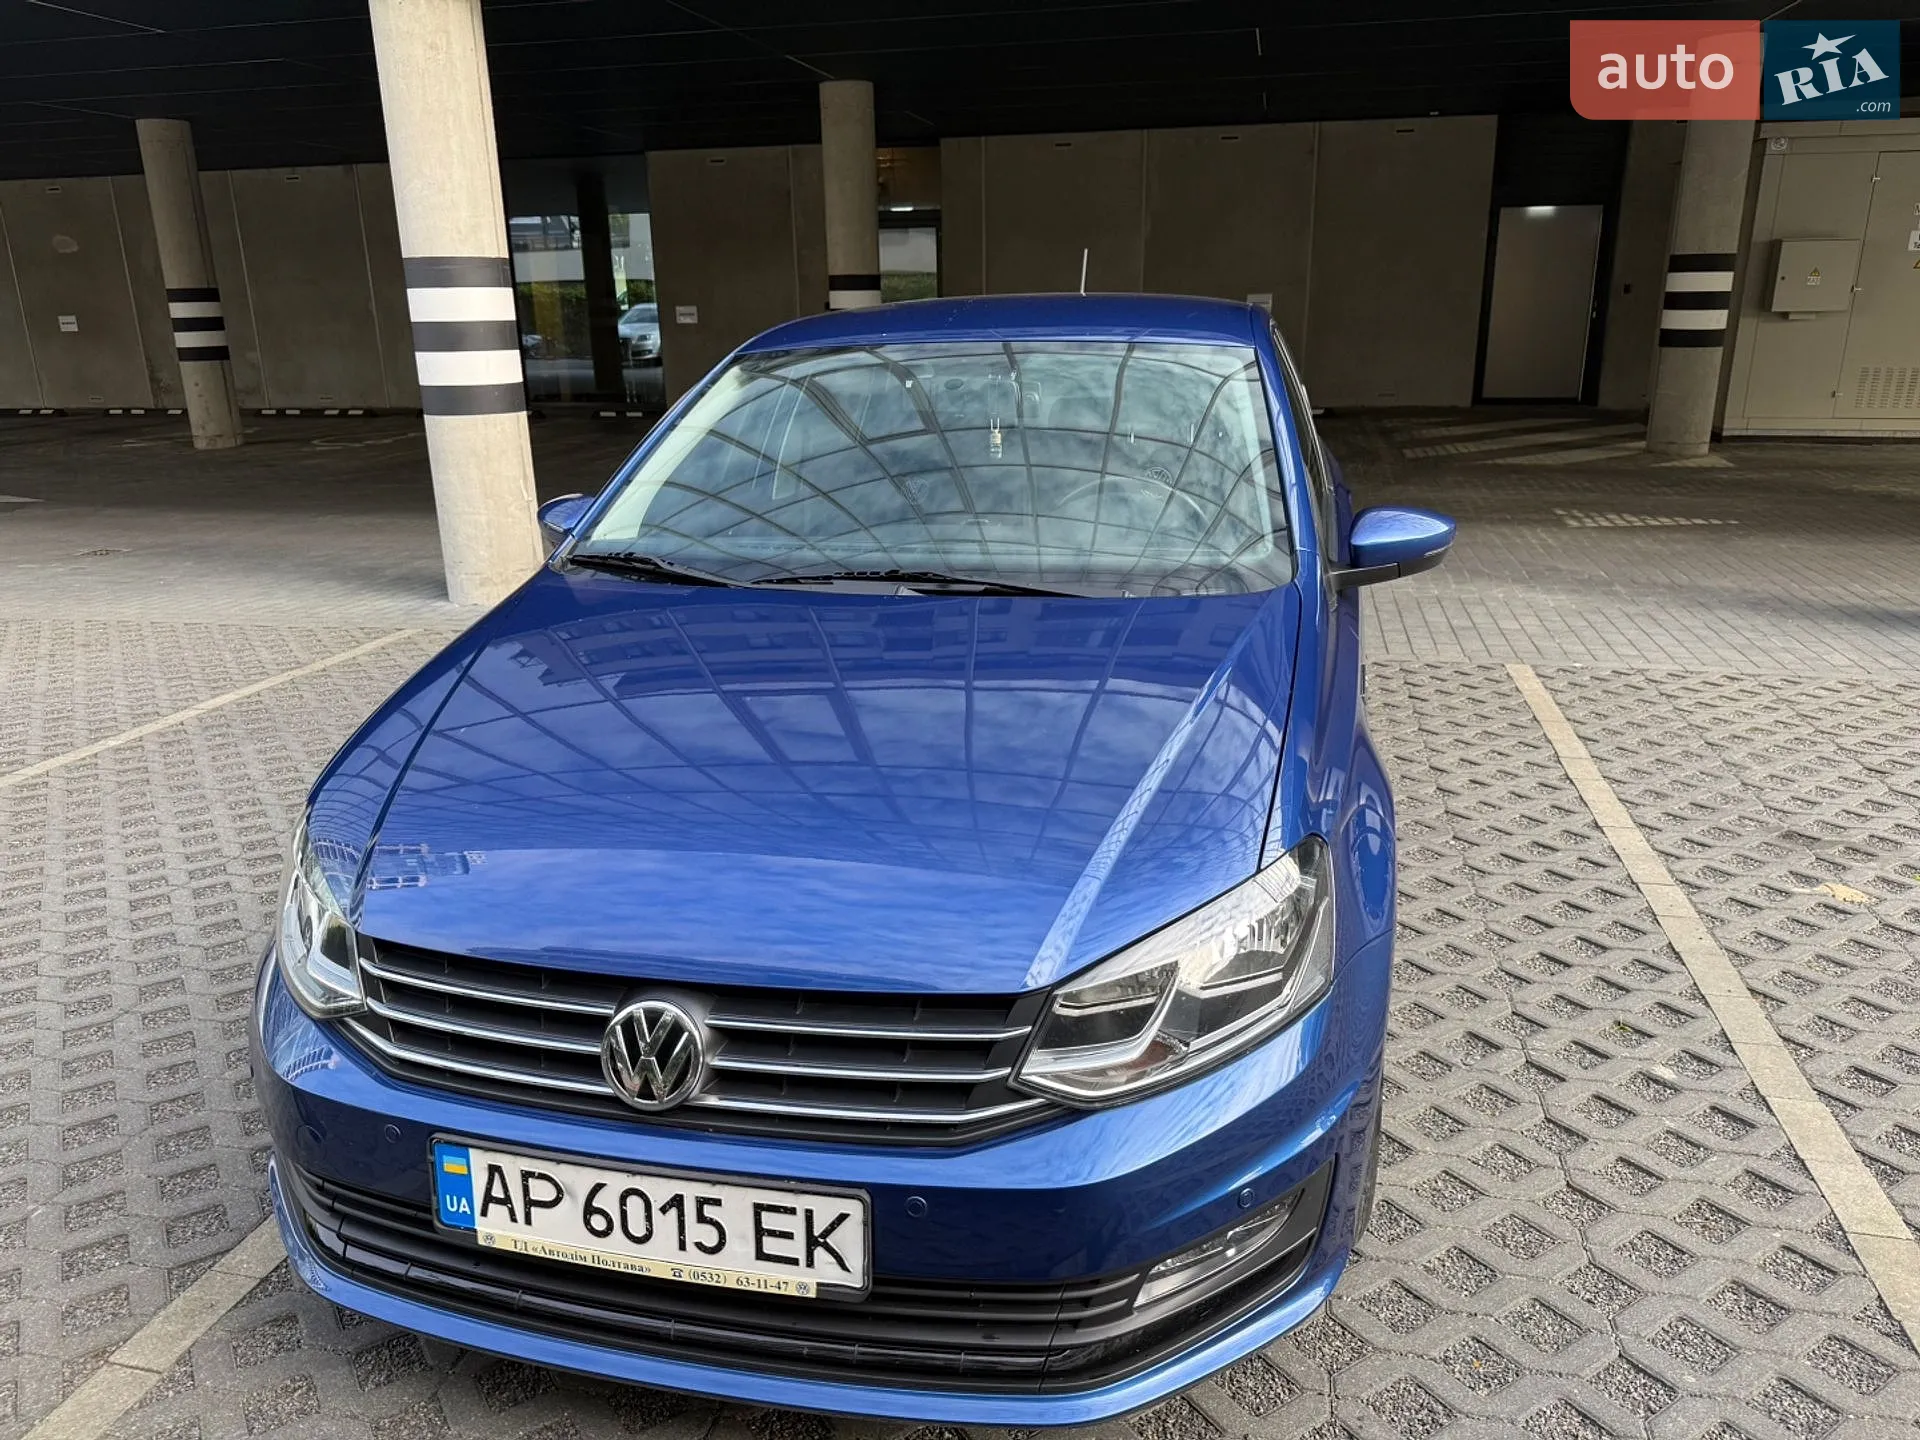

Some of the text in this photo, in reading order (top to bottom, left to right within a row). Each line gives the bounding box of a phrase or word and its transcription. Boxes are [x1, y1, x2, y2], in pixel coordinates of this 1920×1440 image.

[446, 1196, 471, 1215] UA
[480, 1163, 852, 1273] AP 6015 EK
[688, 1269, 727, 1285] (0532)
[736, 1277, 790, 1293] 63-11-47
